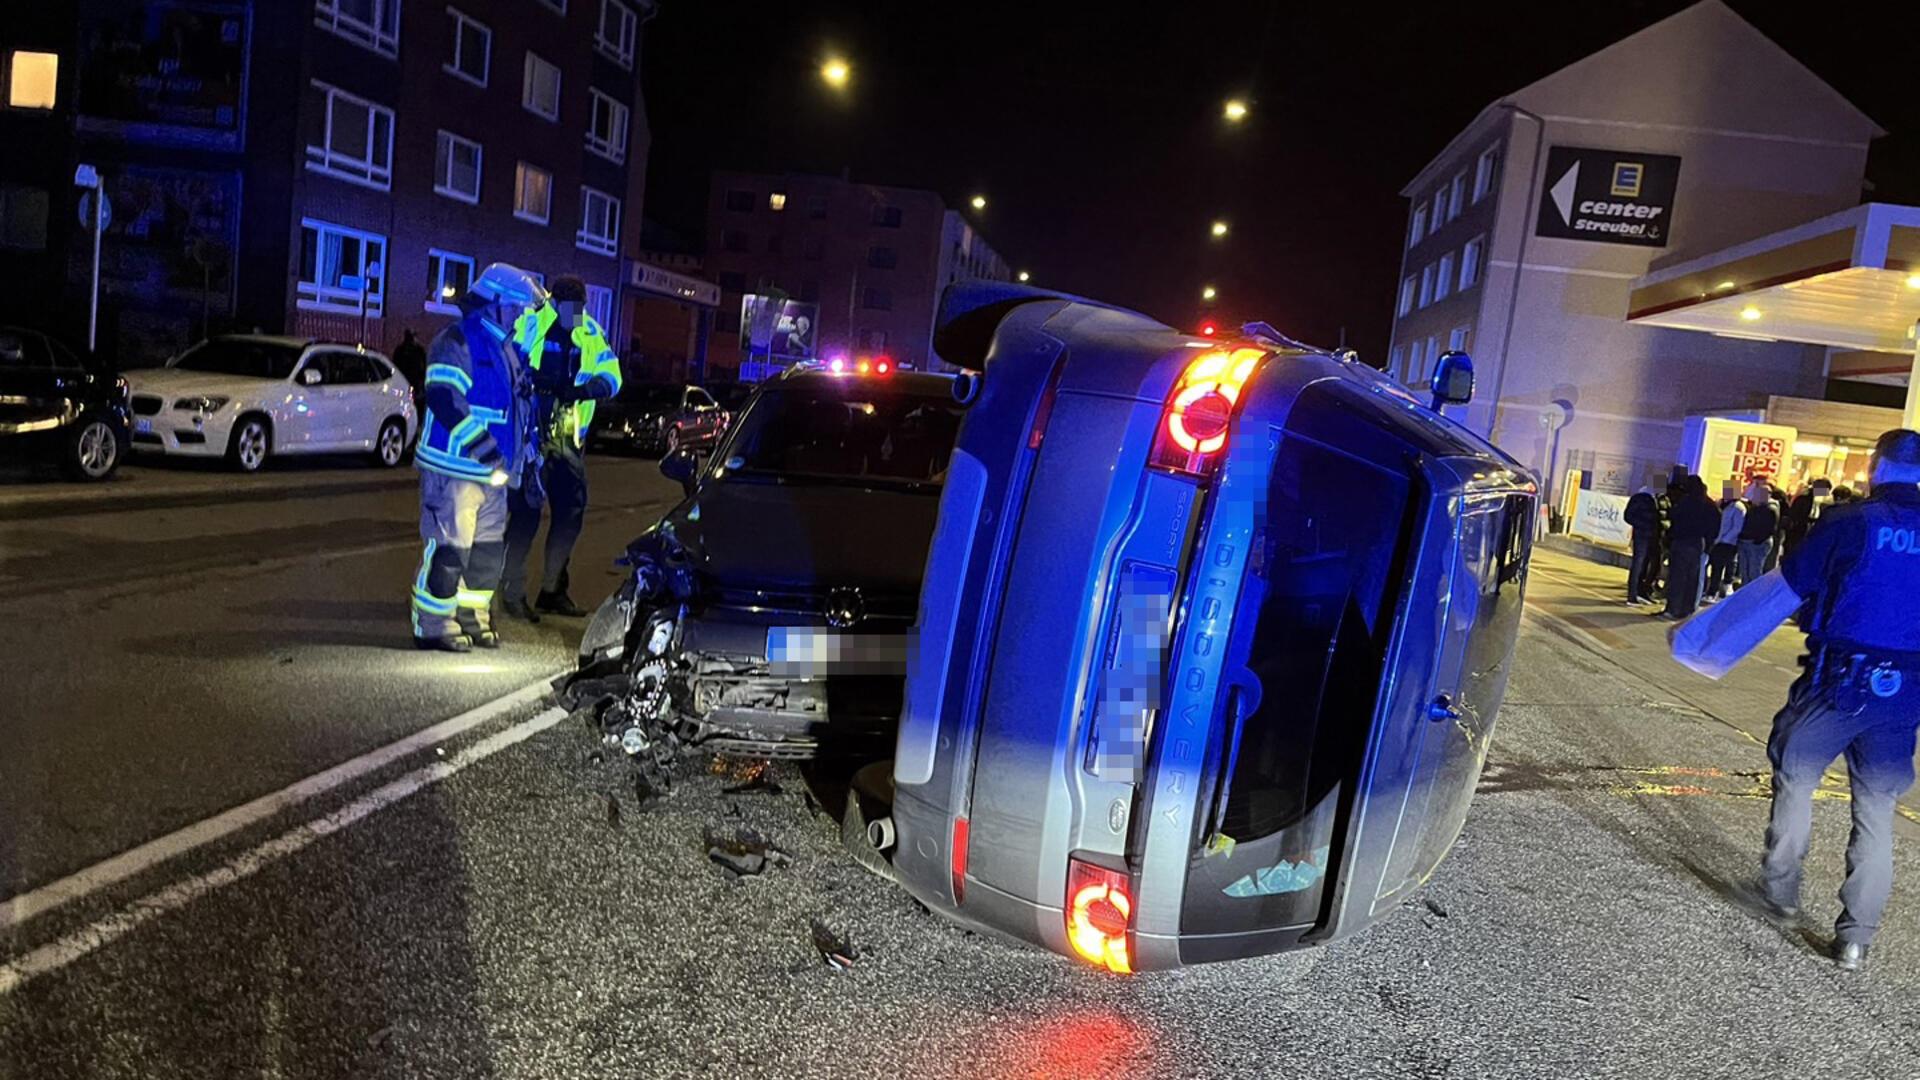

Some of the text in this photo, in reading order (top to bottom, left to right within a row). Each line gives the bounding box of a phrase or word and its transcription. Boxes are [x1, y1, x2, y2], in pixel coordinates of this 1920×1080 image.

[1574, 219, 1646, 235] Streubel
[1579, 201, 1663, 219] center
[1167, 490, 1187, 560] SPORT
[1162, 544, 1236, 828] DISCOVERY
